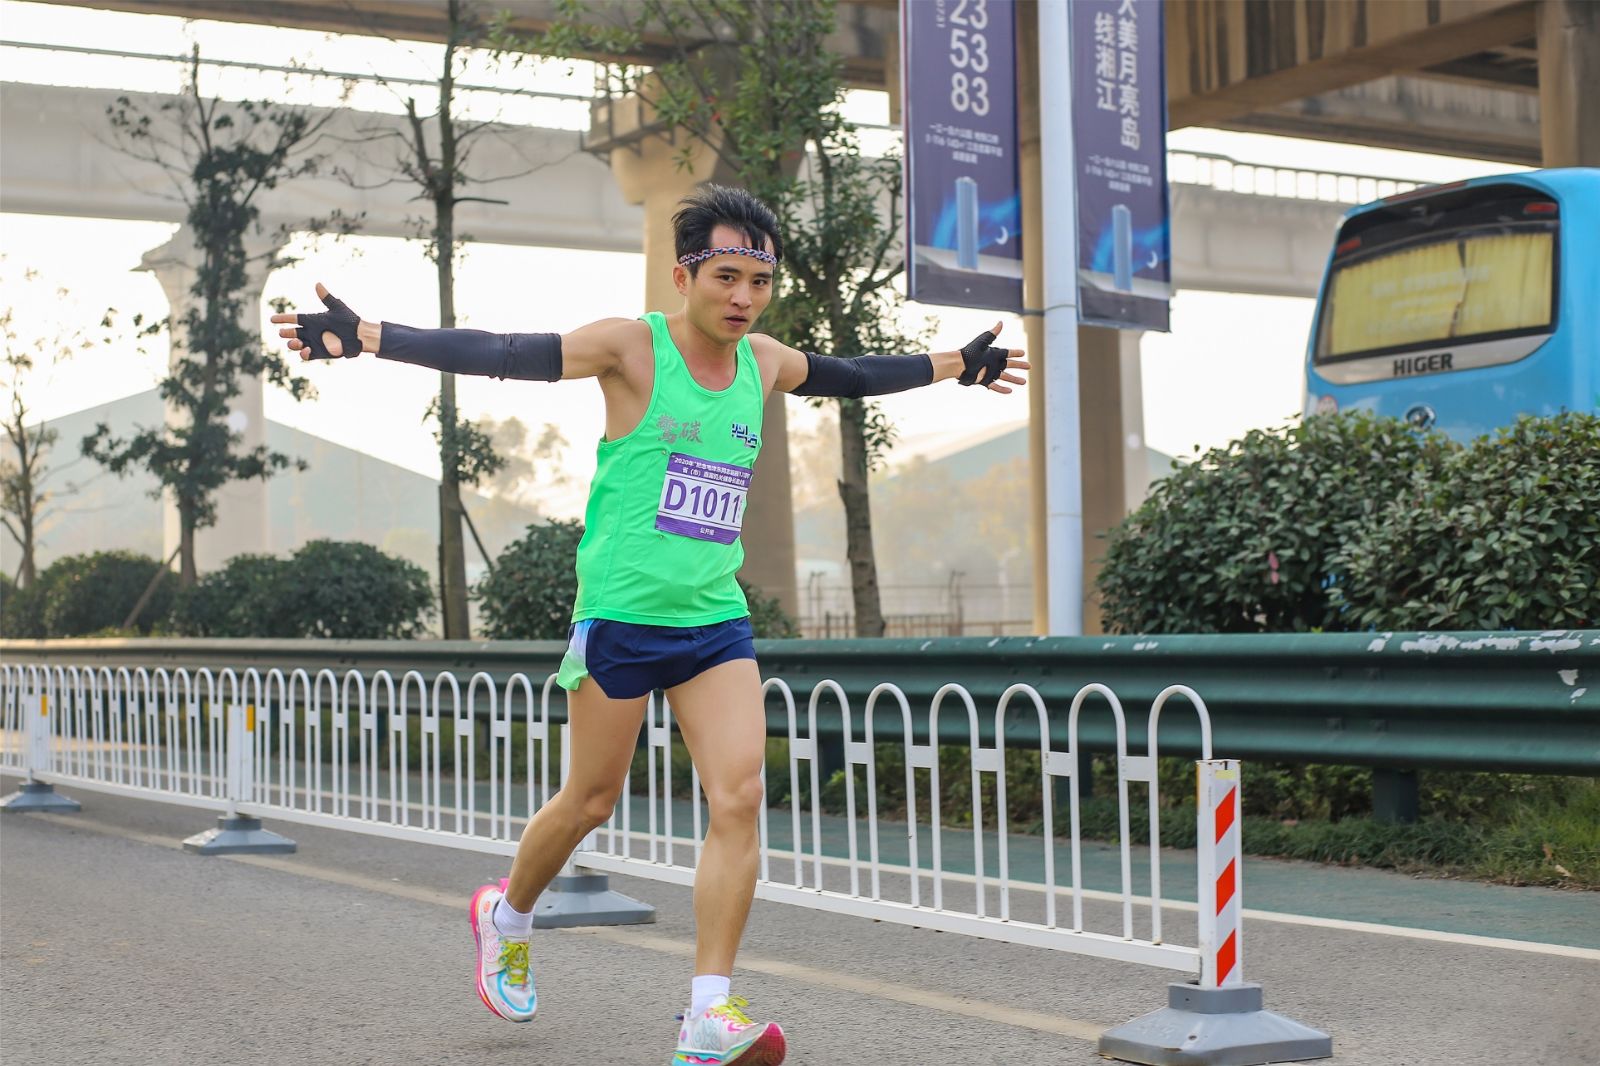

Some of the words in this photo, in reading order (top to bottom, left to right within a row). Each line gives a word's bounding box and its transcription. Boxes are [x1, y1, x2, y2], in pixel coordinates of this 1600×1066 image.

[950, 0, 989, 30] 23
[950, 29, 989, 73] 53
[951, 72, 990, 117] 83
[1394, 352, 1453, 376] HIGER
[664, 478, 741, 524] D1011
